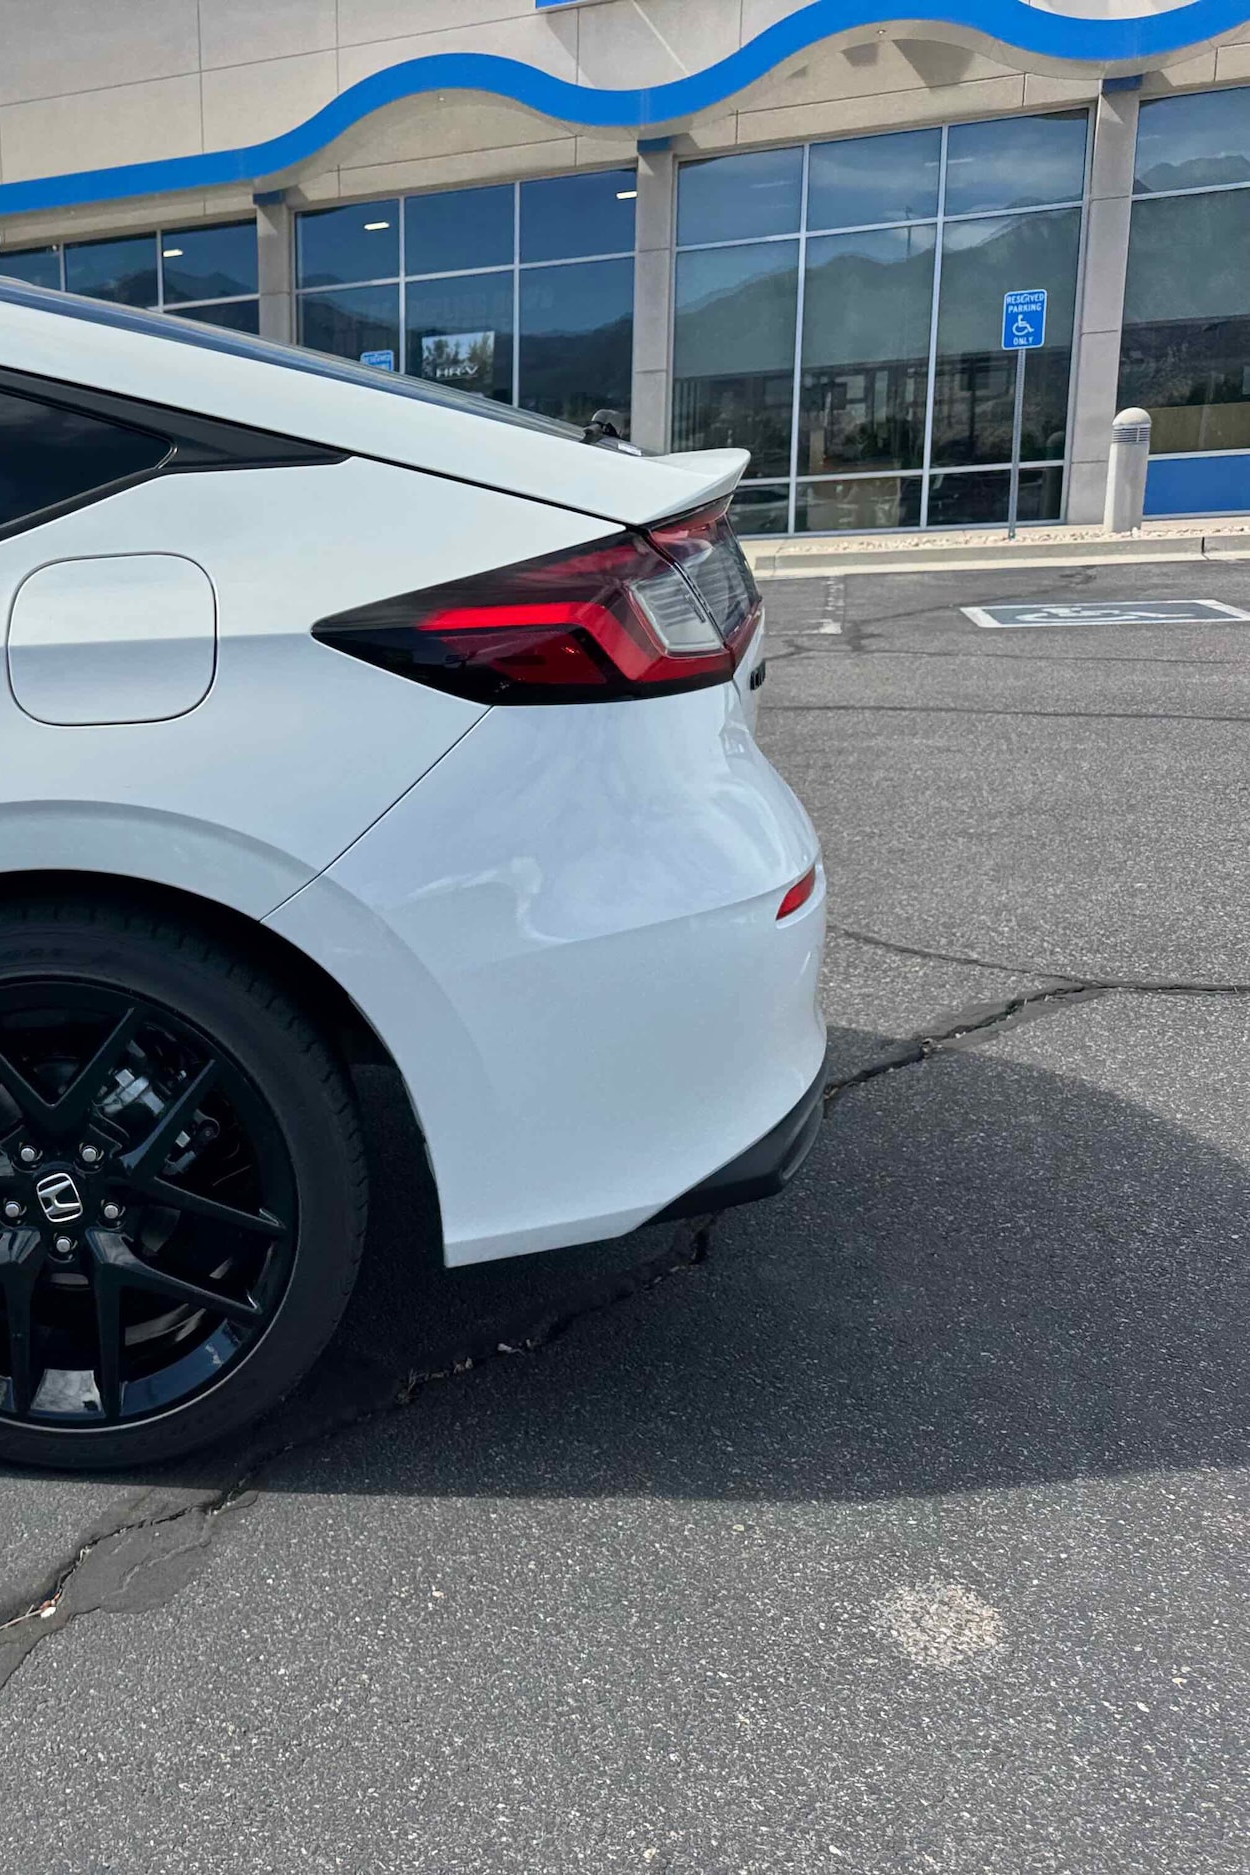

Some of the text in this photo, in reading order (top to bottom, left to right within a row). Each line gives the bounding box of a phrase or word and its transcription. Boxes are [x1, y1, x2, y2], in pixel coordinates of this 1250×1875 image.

[1006, 293, 1044, 304] RESERVED
[1008, 303, 1042, 313] PARKING
[1013, 336, 1034, 346] ONLY
[436, 365, 479, 378] HR-V
